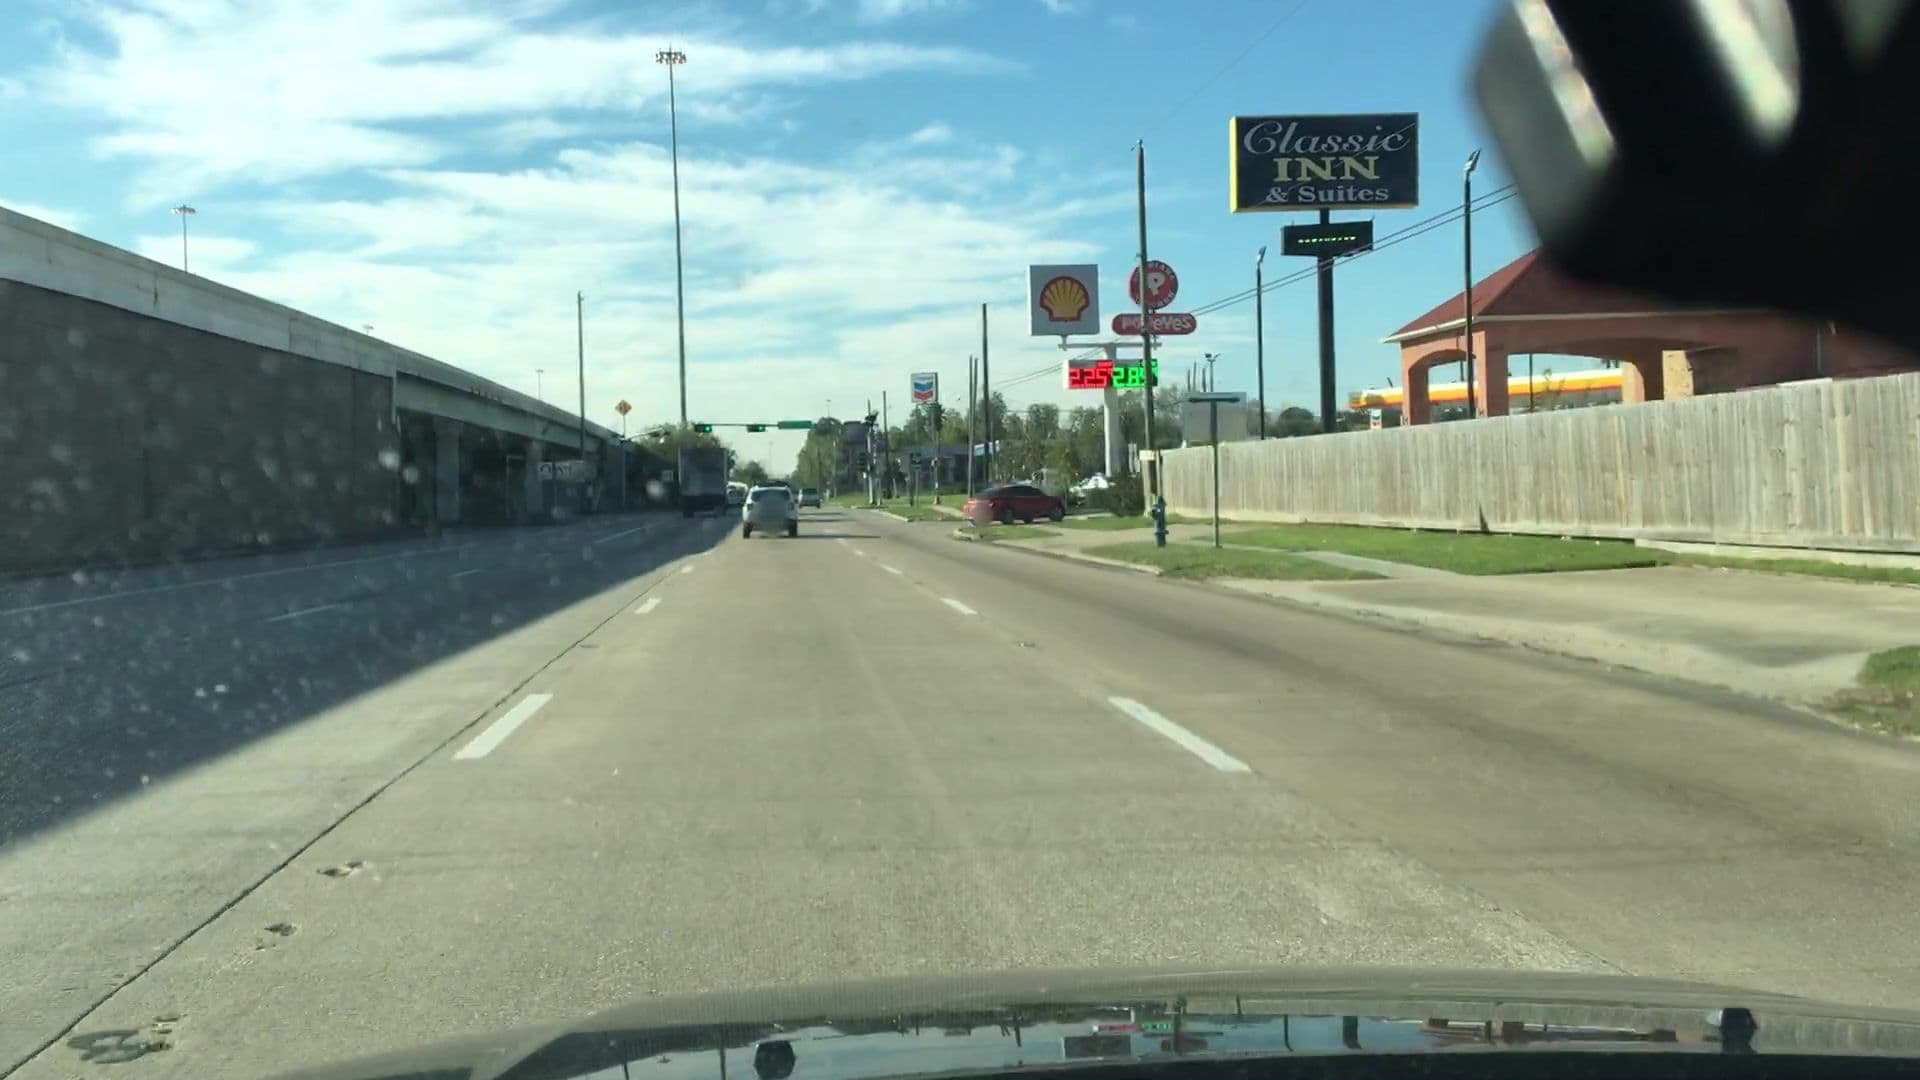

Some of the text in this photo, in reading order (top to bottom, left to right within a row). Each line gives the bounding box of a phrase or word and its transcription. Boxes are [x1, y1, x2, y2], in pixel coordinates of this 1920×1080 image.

[1244, 121, 1410, 154] Classic
[1272, 156, 1380, 182] INN
[1265, 185, 1389, 203] & Suites
